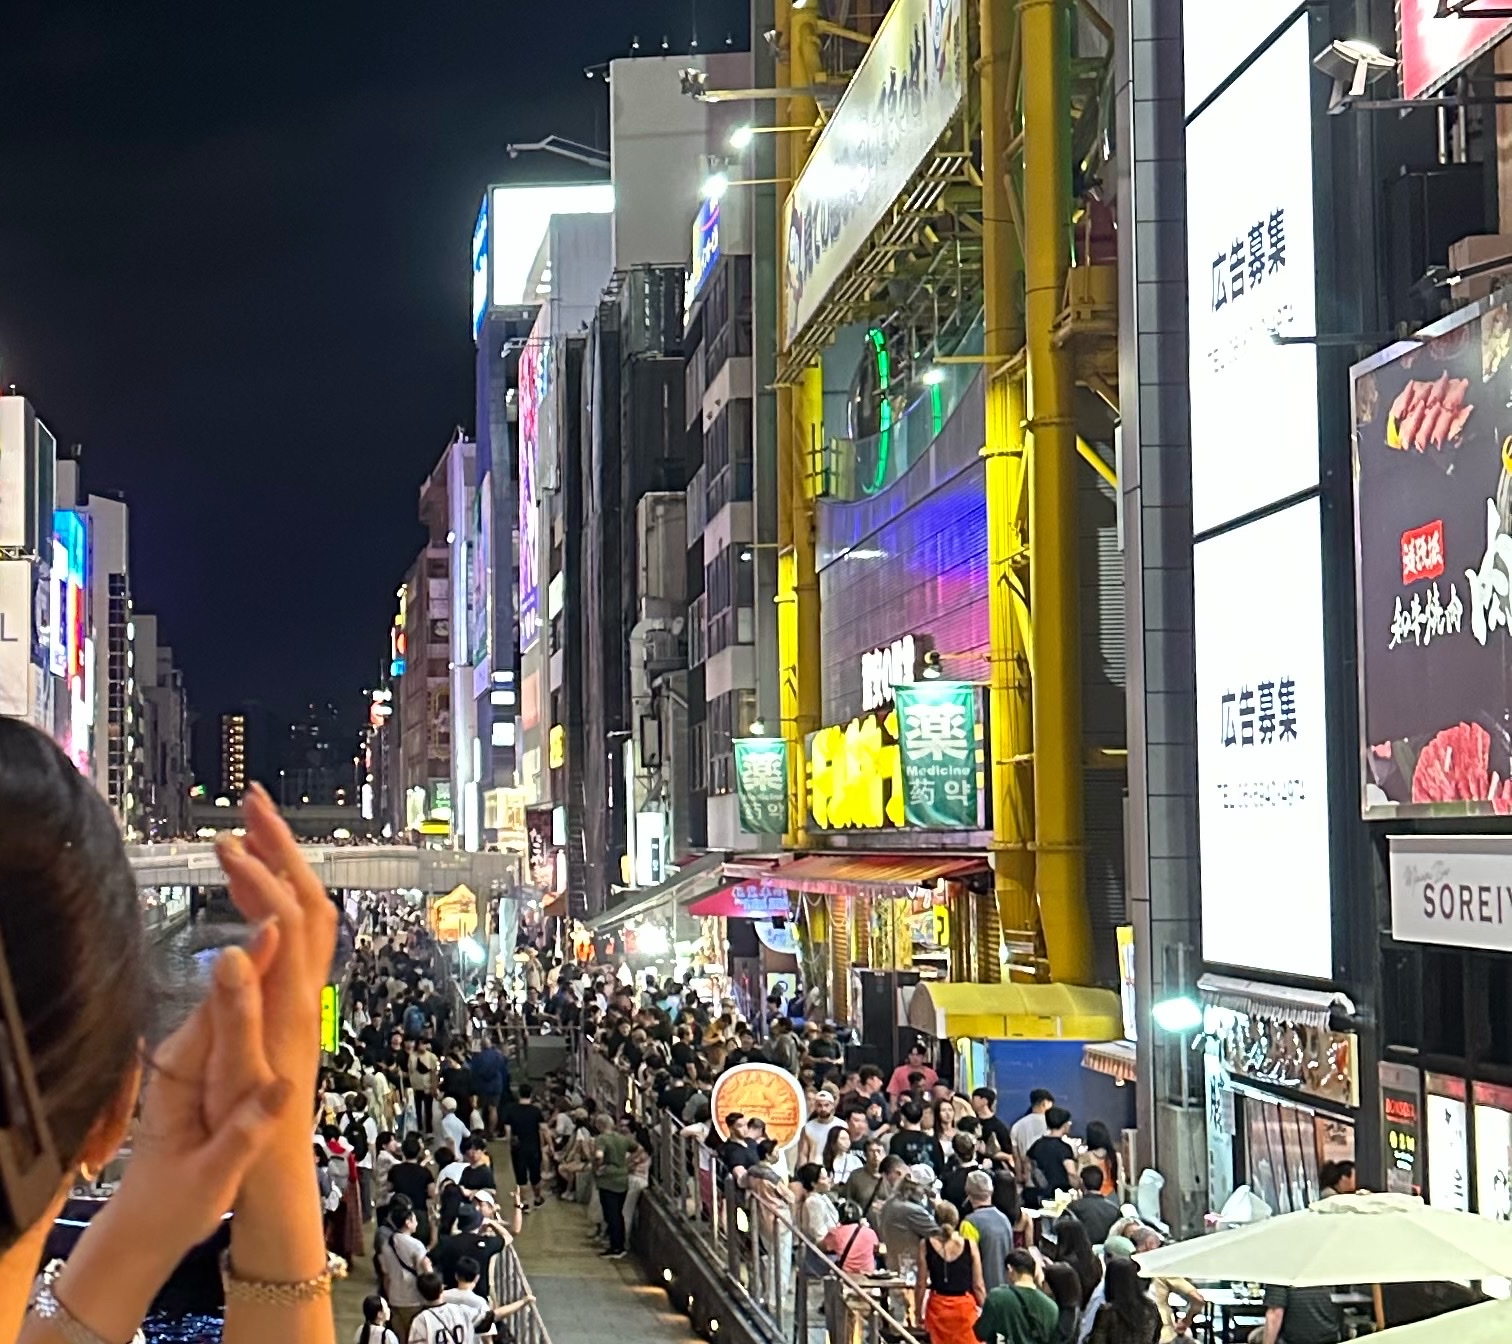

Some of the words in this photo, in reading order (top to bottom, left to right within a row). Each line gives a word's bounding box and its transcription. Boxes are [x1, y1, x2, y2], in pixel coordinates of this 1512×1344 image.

[1211, 206, 1286, 312] 広告募集
[903, 703, 968, 761] 薬
[1221, 675, 1298, 748] 広告募集
[906, 765, 970, 777] Medicine
[944, 780, 972, 806] 약
